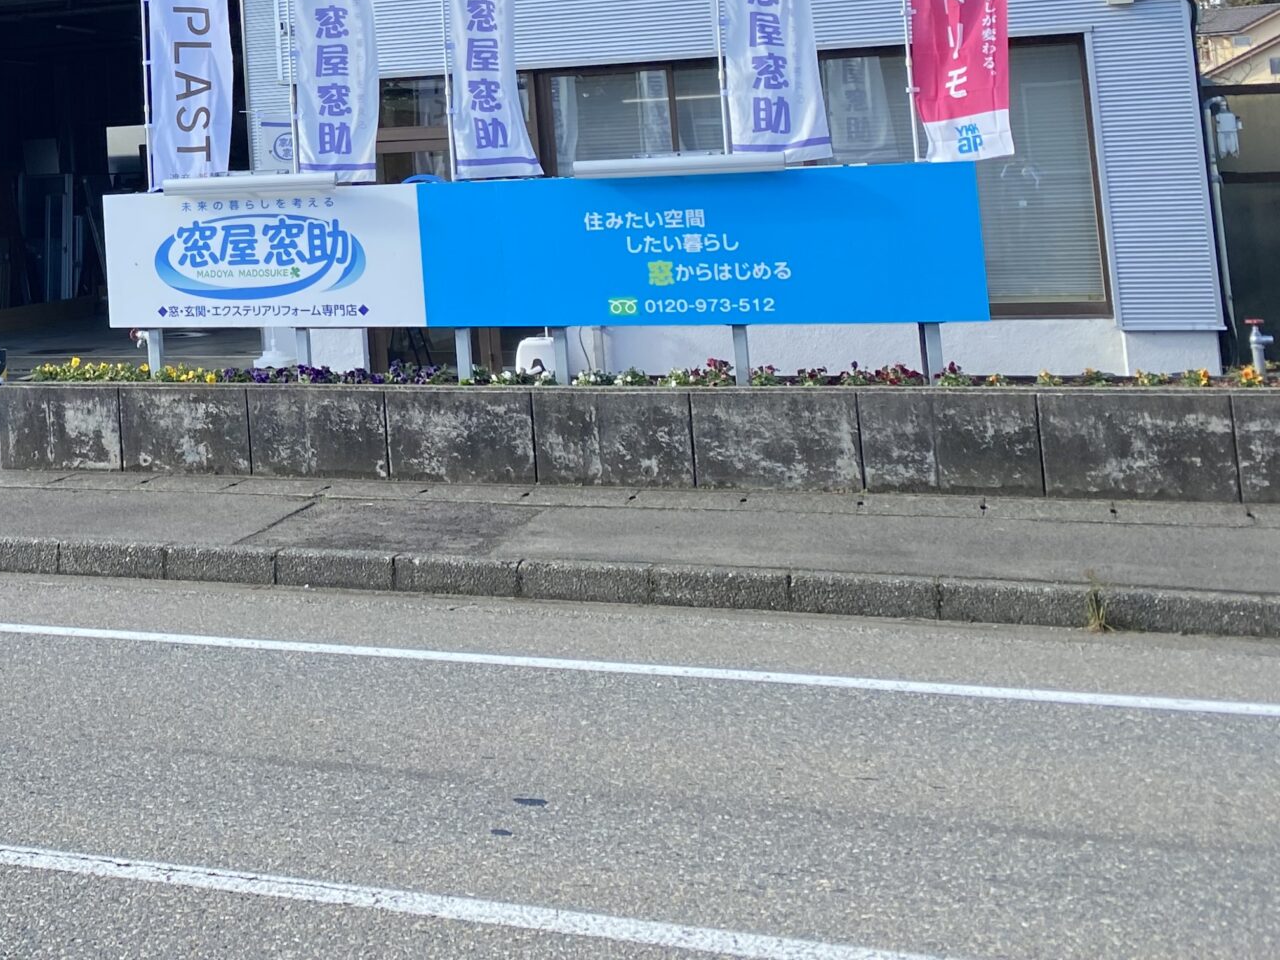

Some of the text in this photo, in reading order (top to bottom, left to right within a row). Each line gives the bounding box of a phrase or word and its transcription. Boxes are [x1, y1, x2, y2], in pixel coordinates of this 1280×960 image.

[172, 6, 213, 162] PLAST
[315, 4, 353, 155] 窓屋窓助
[181, 197, 334, 212] 未来の暮らしを考える
[584, 209, 705, 231] 住みたい空間
[176, 218, 349, 268] 窓屋窓助
[626, 234, 739, 254] したい暮らし
[197, 268, 289, 278] MADOYA MADOSUKE
[647, 260, 792, 286] 窓からはじめる
[168, 304, 358, 317] 窓・玄関・エクステリアリフォーム専門店
[644, 297, 776, 313] 0120-973-512
